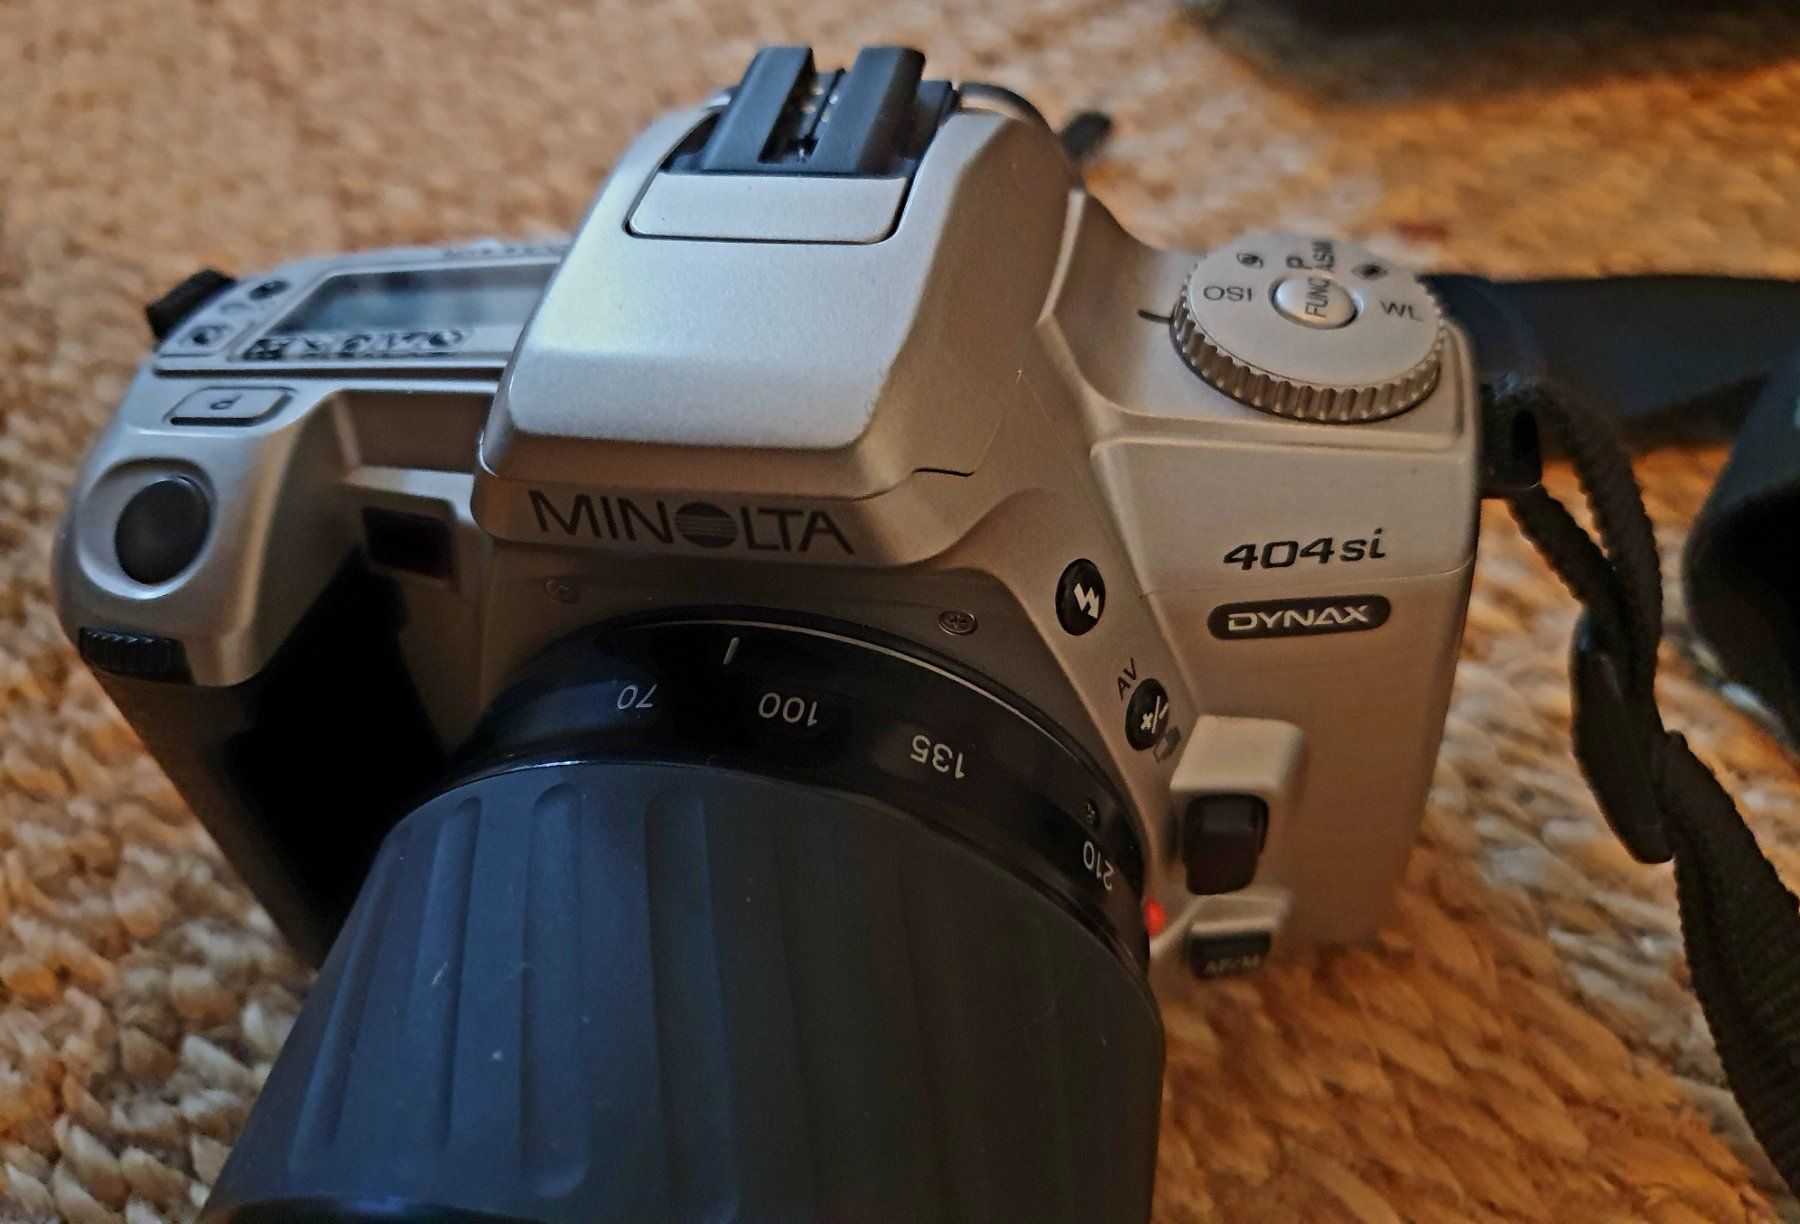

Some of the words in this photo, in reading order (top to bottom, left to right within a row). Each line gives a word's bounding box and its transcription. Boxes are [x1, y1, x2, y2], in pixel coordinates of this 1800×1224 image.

[1222, 527, 1387, 571] 404si
[1227, 604, 1370, 633] DYNAX
[616, 683, 658, 711] 70
[1116, 656, 1138, 701] AV
[758, 691, 819, 728] 100
[909, 733, 967, 780] 135
[1082, 840, 1114, 892] 210
